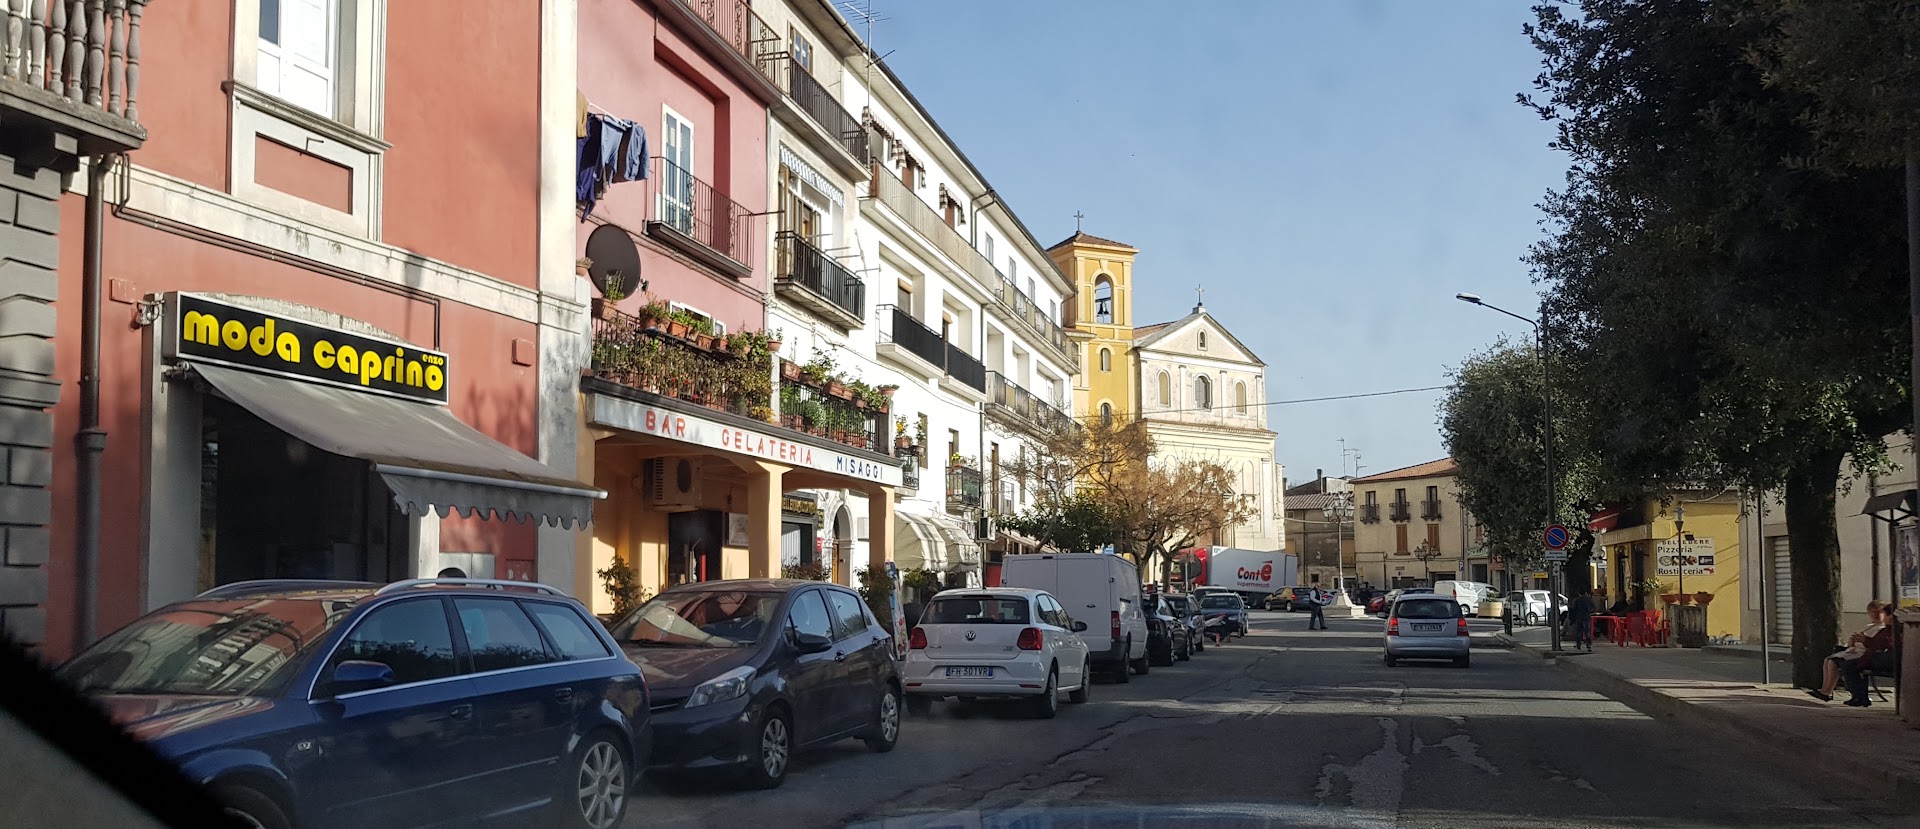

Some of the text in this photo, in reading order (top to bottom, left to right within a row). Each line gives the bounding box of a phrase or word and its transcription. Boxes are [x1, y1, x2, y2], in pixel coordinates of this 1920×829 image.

[183, 310, 444, 392] moda caprino
[422, 353, 444, 366] enzo
[646, 410, 883, 480] BAR GELATERIA MISAGGI
[1658, 567, 1704, 575] Rosticeria
